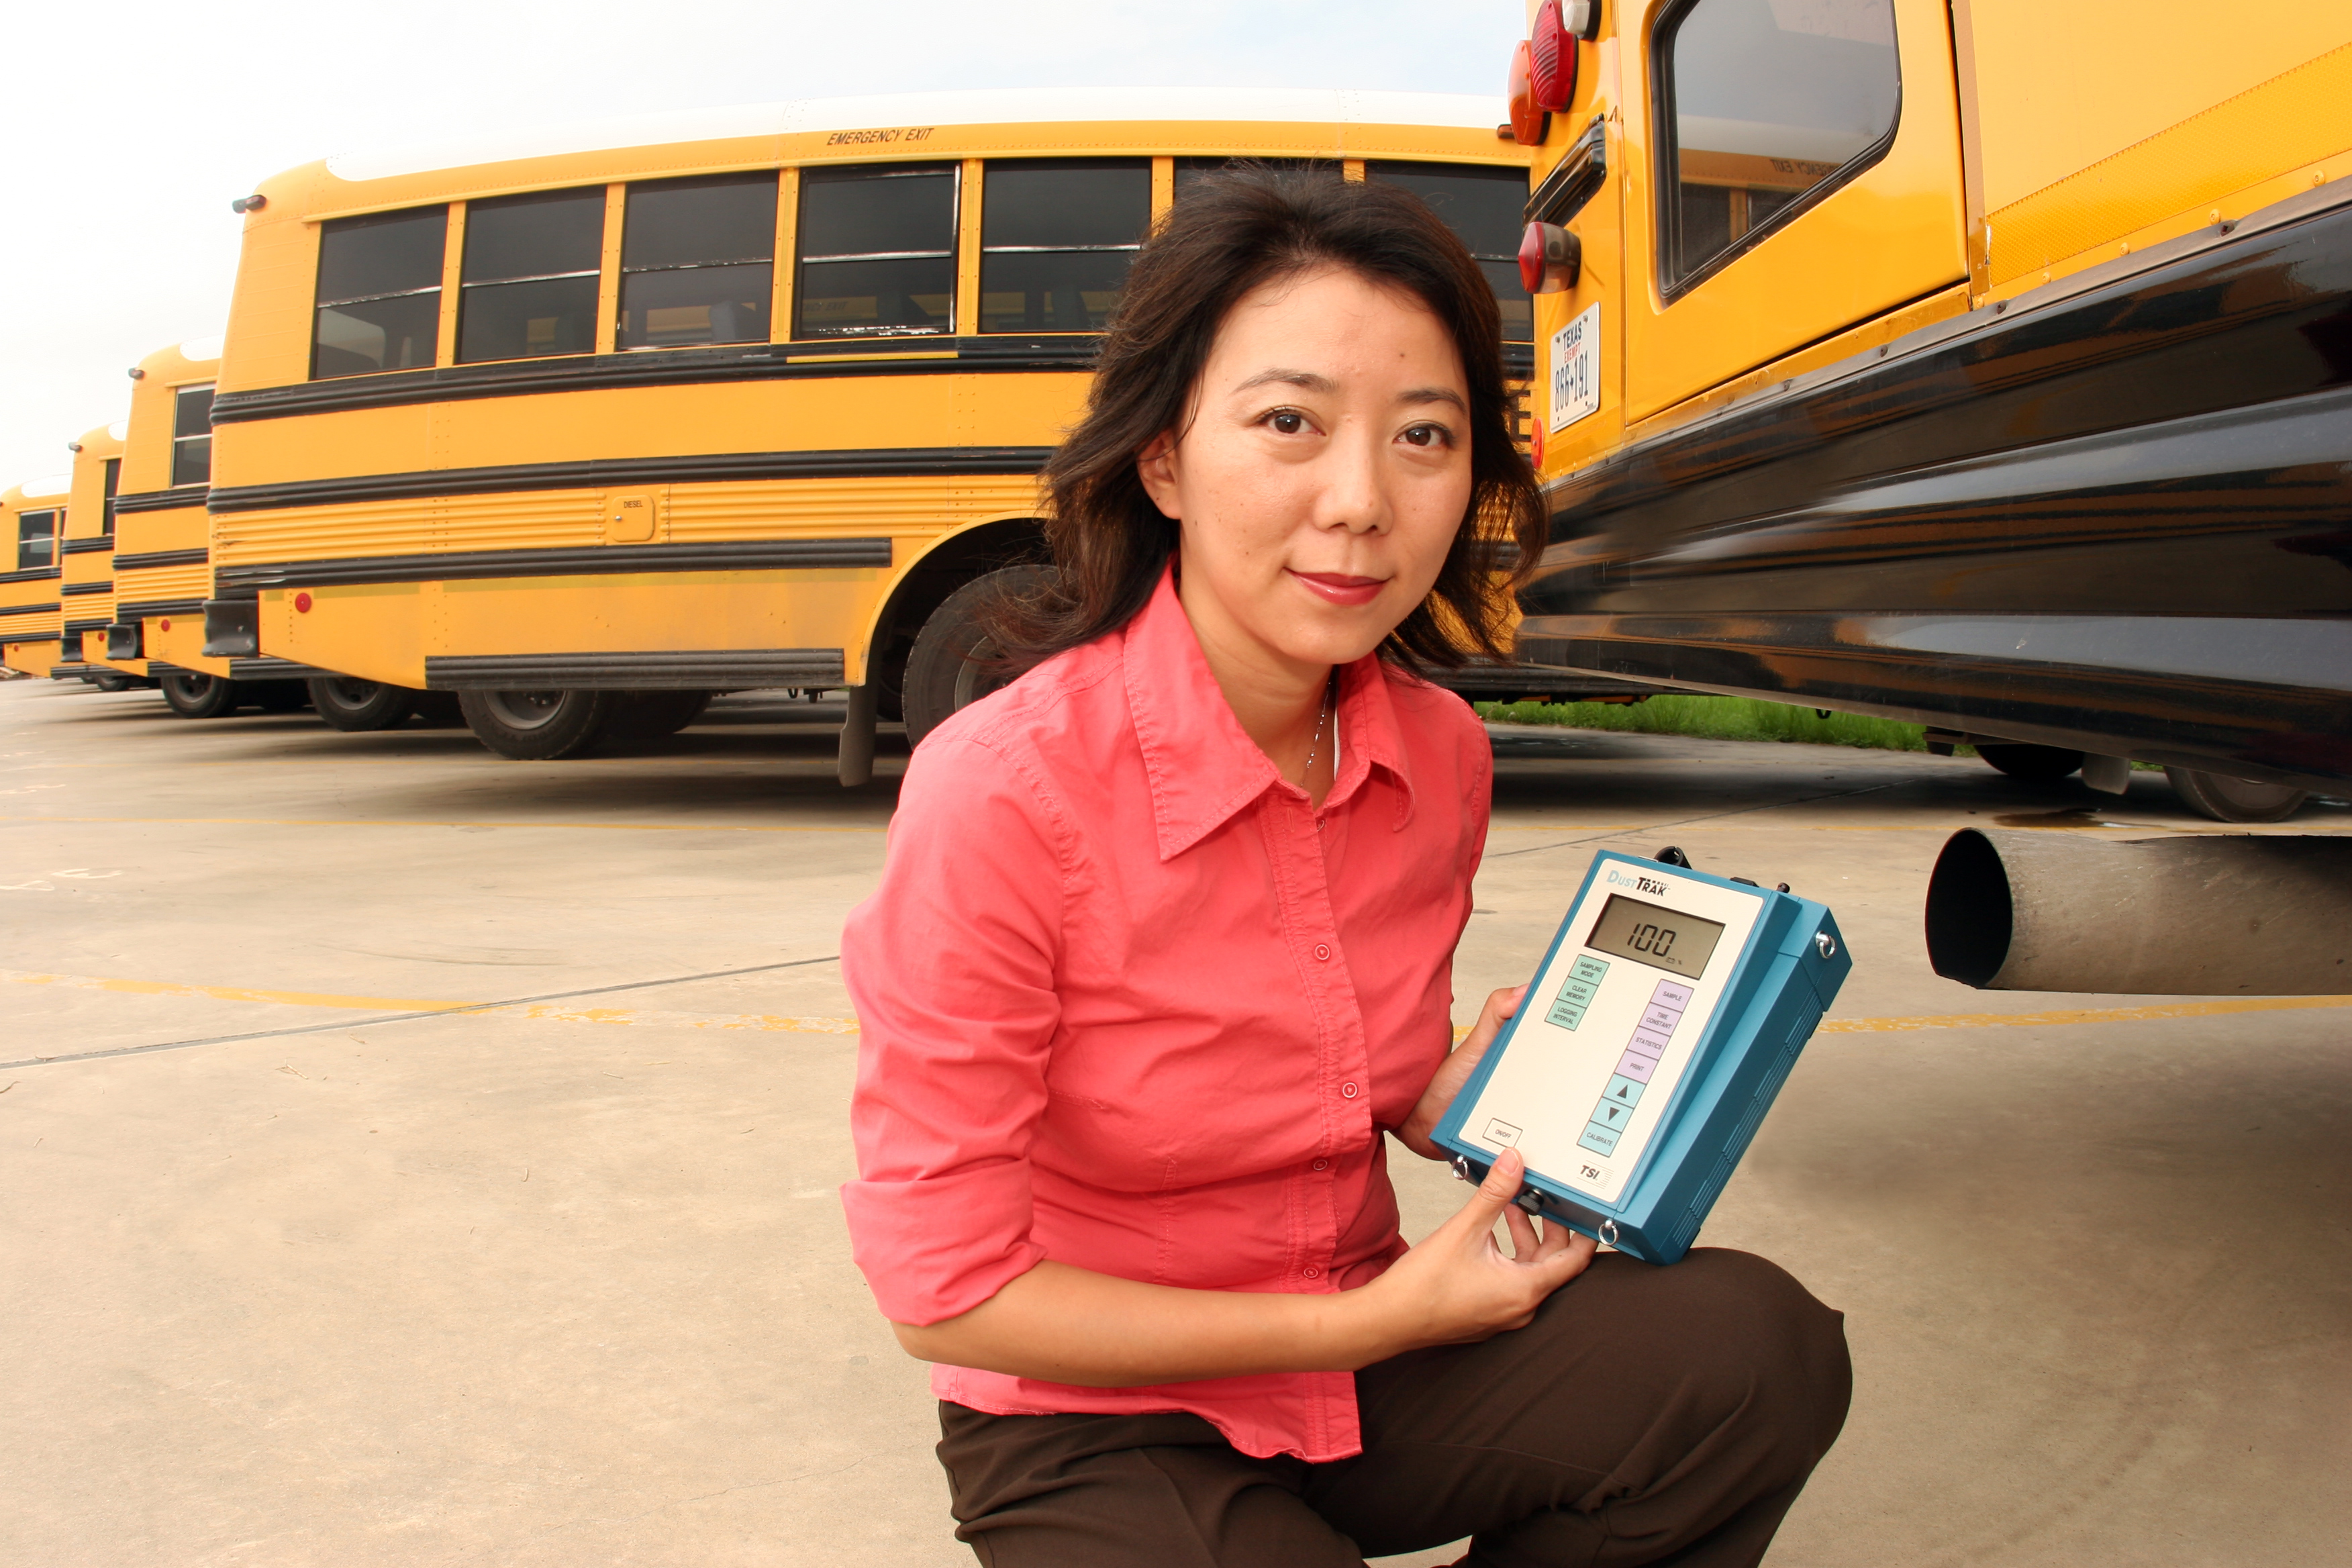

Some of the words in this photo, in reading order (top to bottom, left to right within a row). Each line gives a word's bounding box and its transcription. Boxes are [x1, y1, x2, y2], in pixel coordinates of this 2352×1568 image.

[826, 128, 904, 146] EMERGENCY
[905, 128, 934, 141] EXIT
[1563, 321, 1582, 351] TEXAS
[1564, 342, 1581, 364] EXEMPT
[624, 500, 643, 508] DIESEL
[1627, 923, 1676, 957] 100
[1579, 961, 1602, 973] SAMPLING
[1581, 970, 1594, 978] MODE
[1572, 985, 1587, 993] CLEAR
[1566, 991, 1585, 1001] MEMORY
[1663, 991, 1682, 1001] SAMPLE
[1557, 1007, 1577, 1017] LOGGING
[1657, 1012, 1668, 1020] TIME
[1553, 1014, 1573, 1024] INTERVAL
[1646, 1017, 1672, 1029] CONSTANT
[1635, 1037, 1662, 1050] STATISTICS
[1629, 1063, 1645, 1072] PRINT
[1586, 1132, 1613, 1146] CALIBRATE
[1580, 1165, 1601, 1179] TSI
